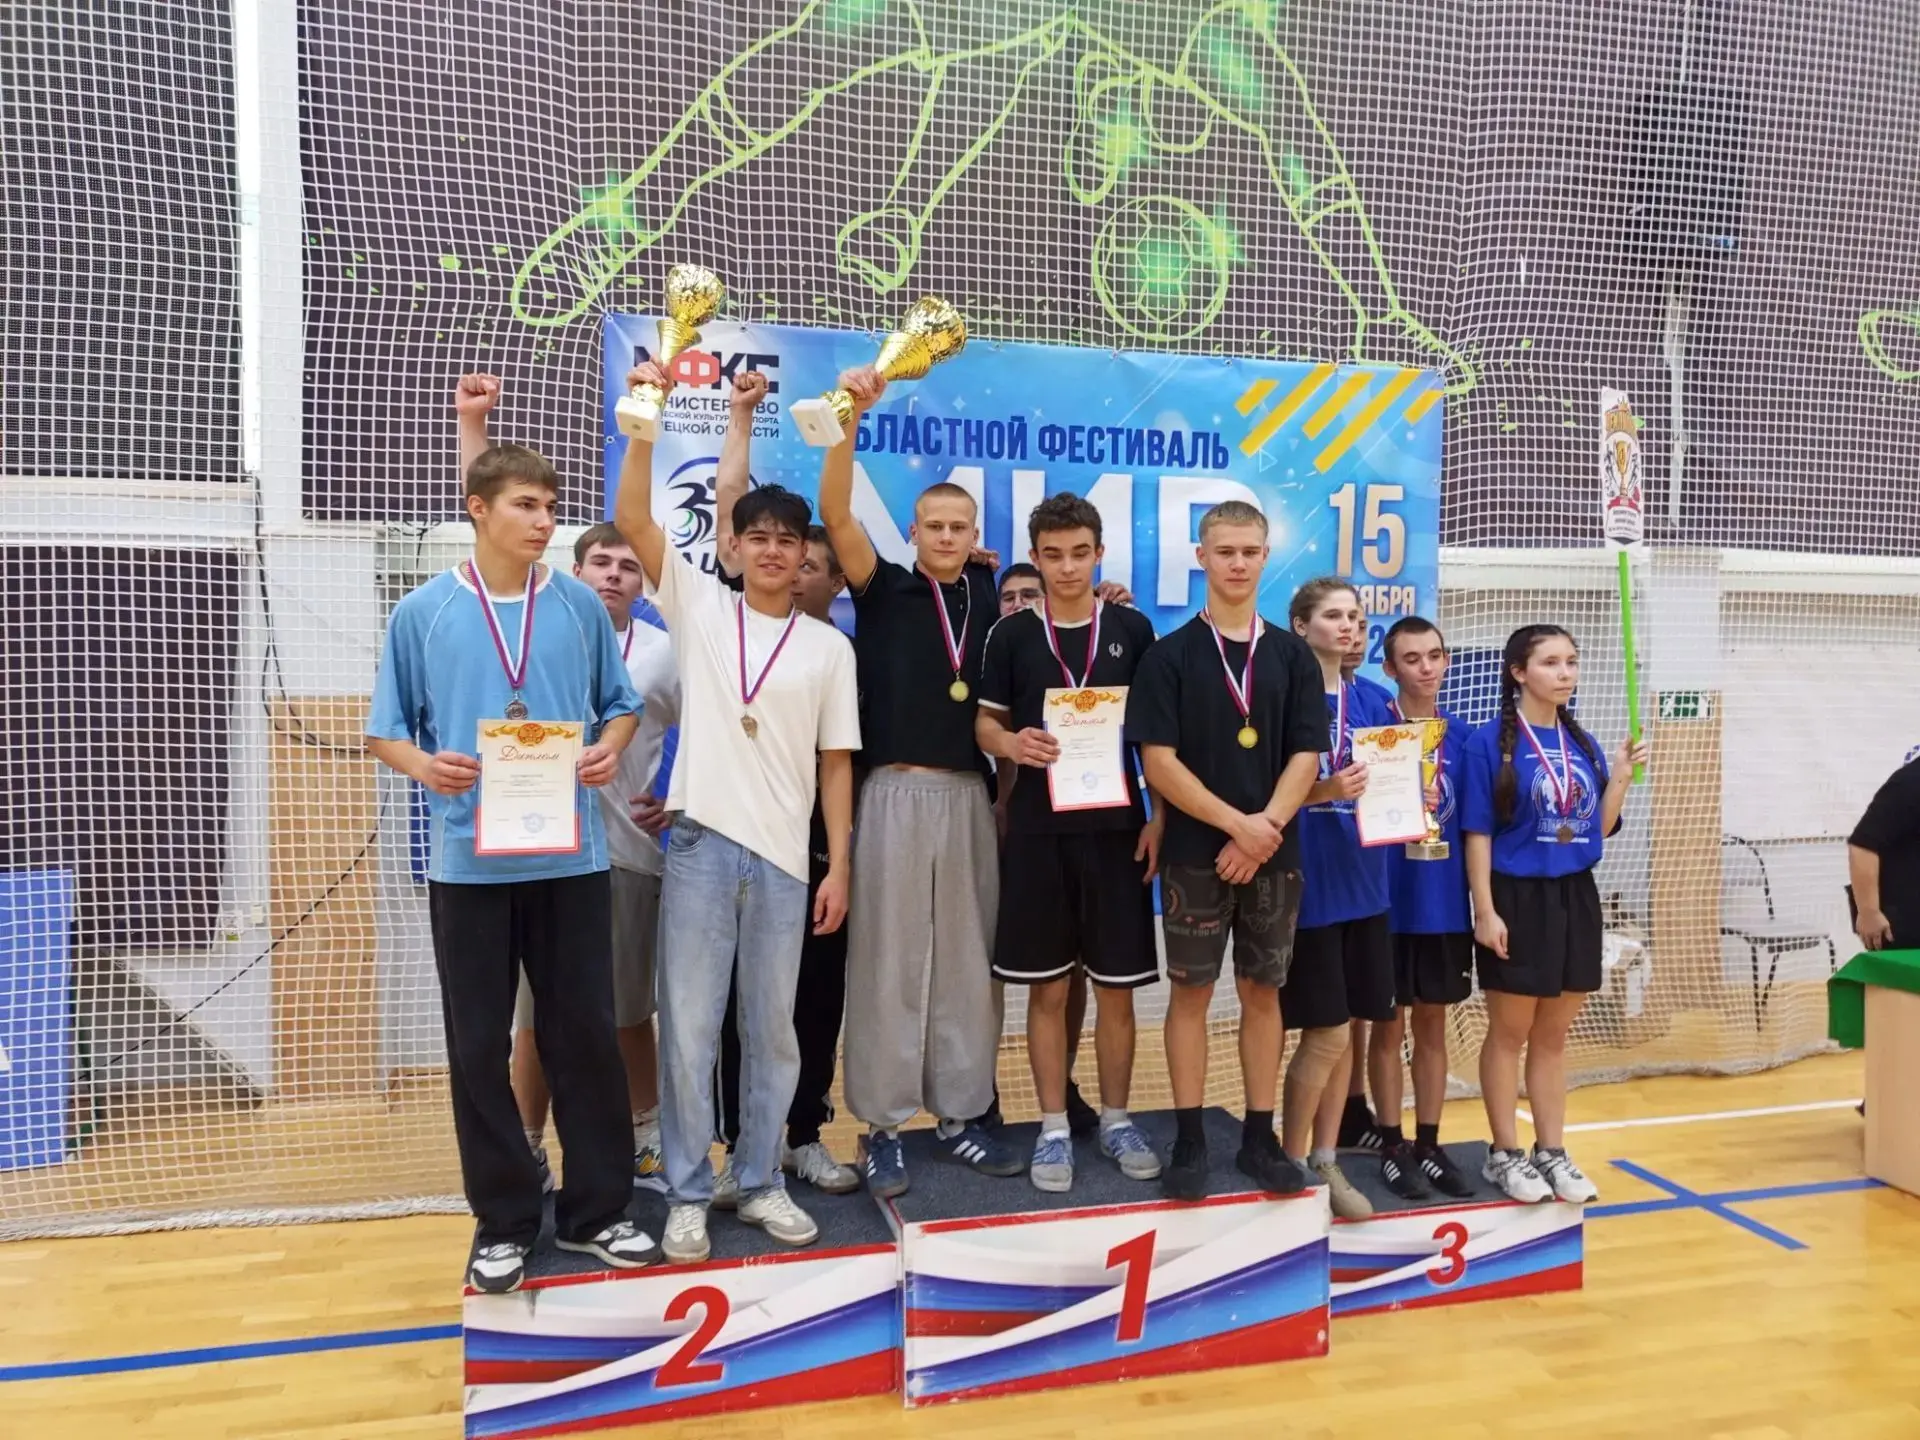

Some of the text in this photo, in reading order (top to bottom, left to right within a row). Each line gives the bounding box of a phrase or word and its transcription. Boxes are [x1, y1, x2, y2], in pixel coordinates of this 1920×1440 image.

[661, 420, 711, 436] ЕЦКОЙ
[665, 396, 779, 415] НИСТЕРВО
[693, 412, 730, 422] КУЛЬТУР
[751, 416, 779, 425] ПОРТА
[855, 412, 1229, 470] БЛАСТНОЙ ФЕСТИВАЛЬ
[1329, 483, 1405, 580] 15
[1426, 1221, 1469, 1285] 3
[1105, 1228, 1157, 1342] 1
[654, 1285, 731, 1388] 2
